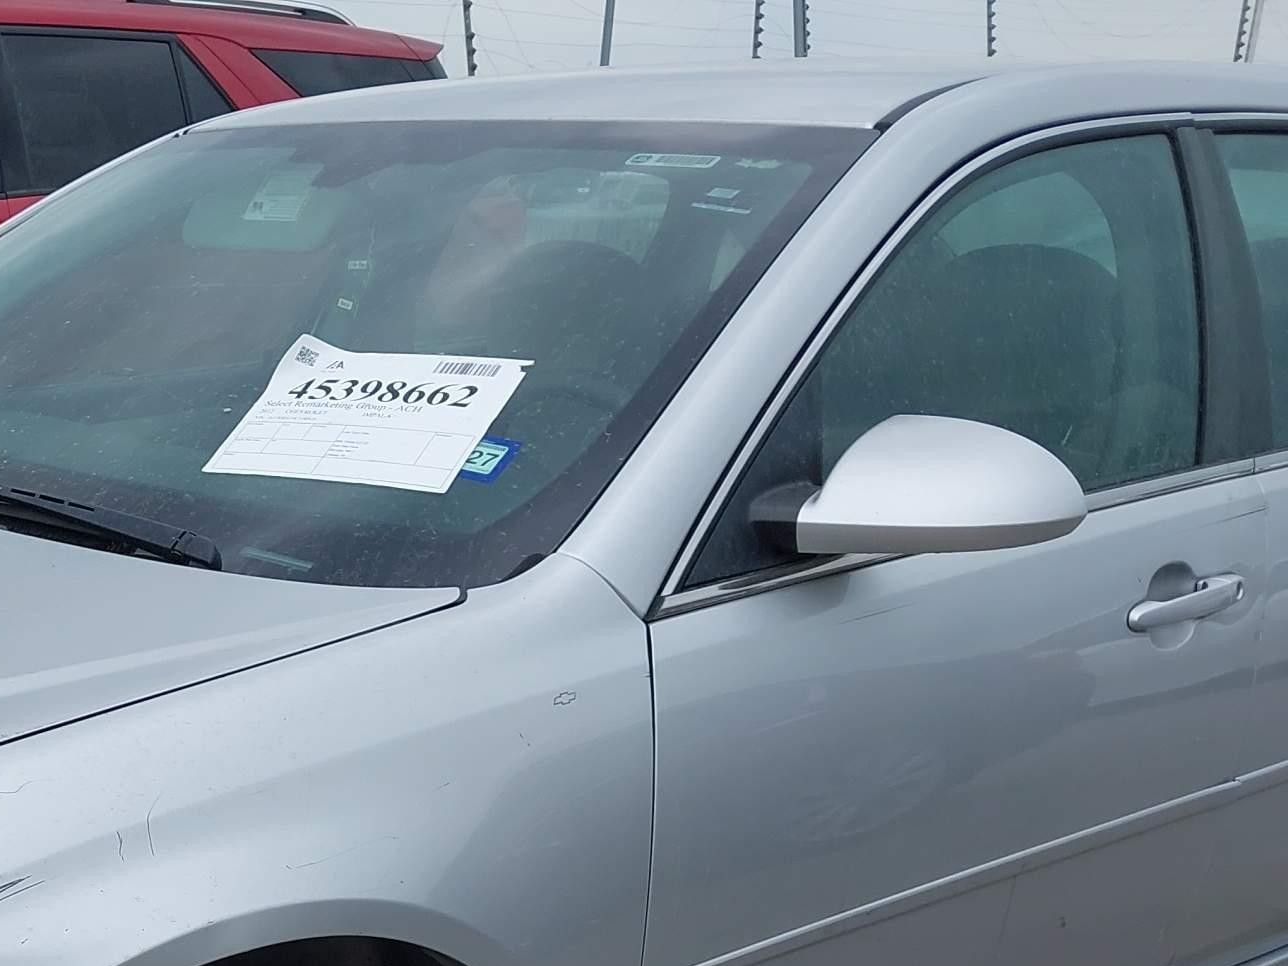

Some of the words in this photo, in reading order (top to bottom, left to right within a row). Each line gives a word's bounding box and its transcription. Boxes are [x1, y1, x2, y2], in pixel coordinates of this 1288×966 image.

[288, 378, 479, 408] 45398662
[265, 400, 293, 408] Select
[294, 400, 353, 410] Remarketing
[355, 402, 387, 412] Group
[394, 405, 424, 413] ACH
[465, 450, 500, 467] 27
